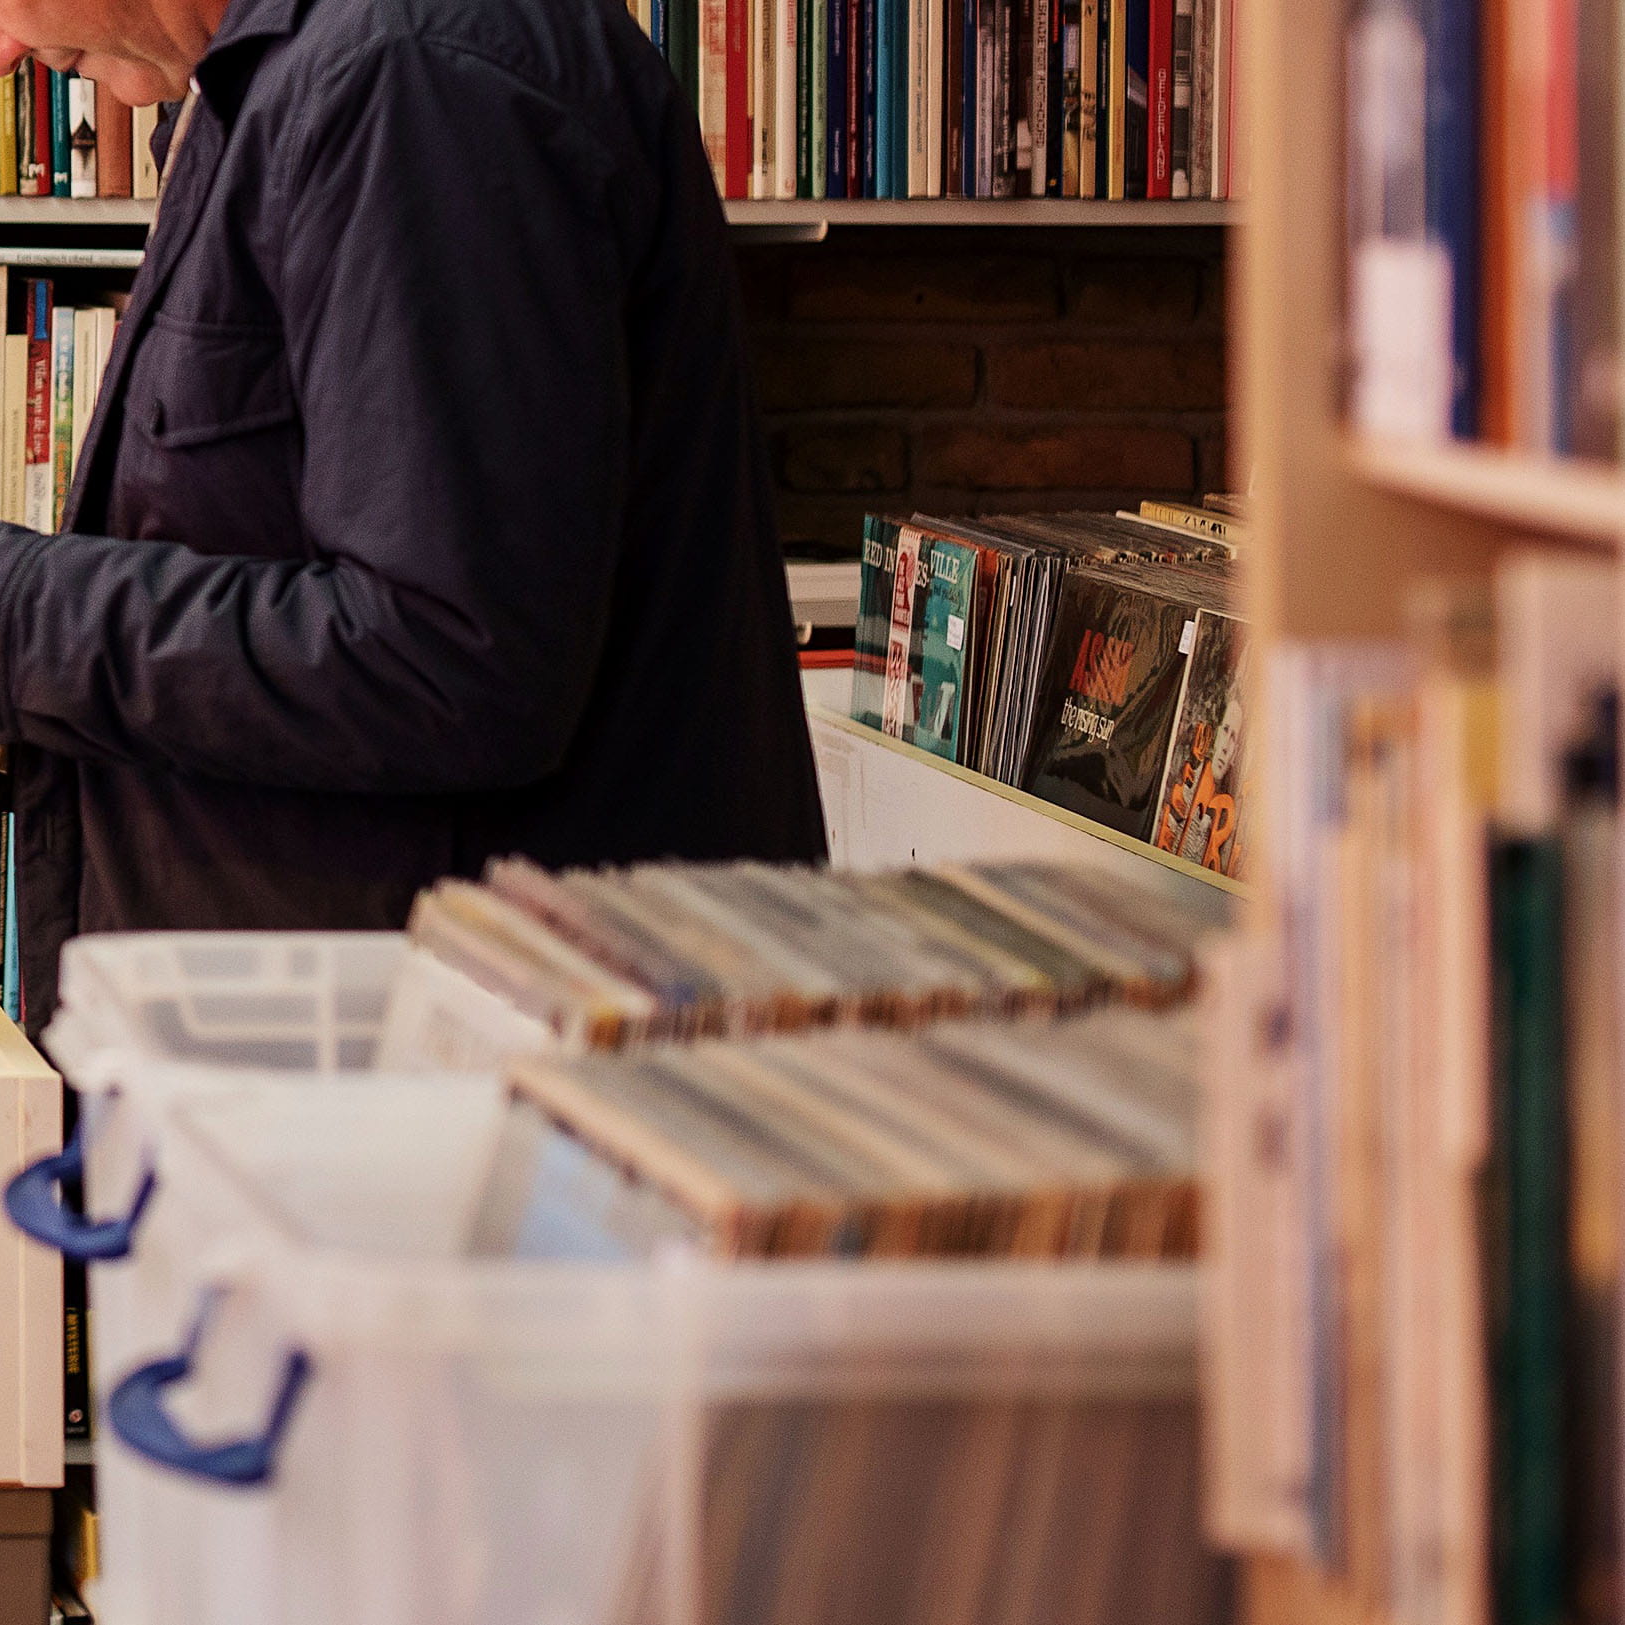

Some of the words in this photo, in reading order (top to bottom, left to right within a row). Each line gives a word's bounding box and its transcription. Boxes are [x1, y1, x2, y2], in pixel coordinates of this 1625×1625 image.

[1062, 696, 1079, 724] the
[1077, 706, 1099, 745] rising
[1098, 718, 1117, 750] sun
